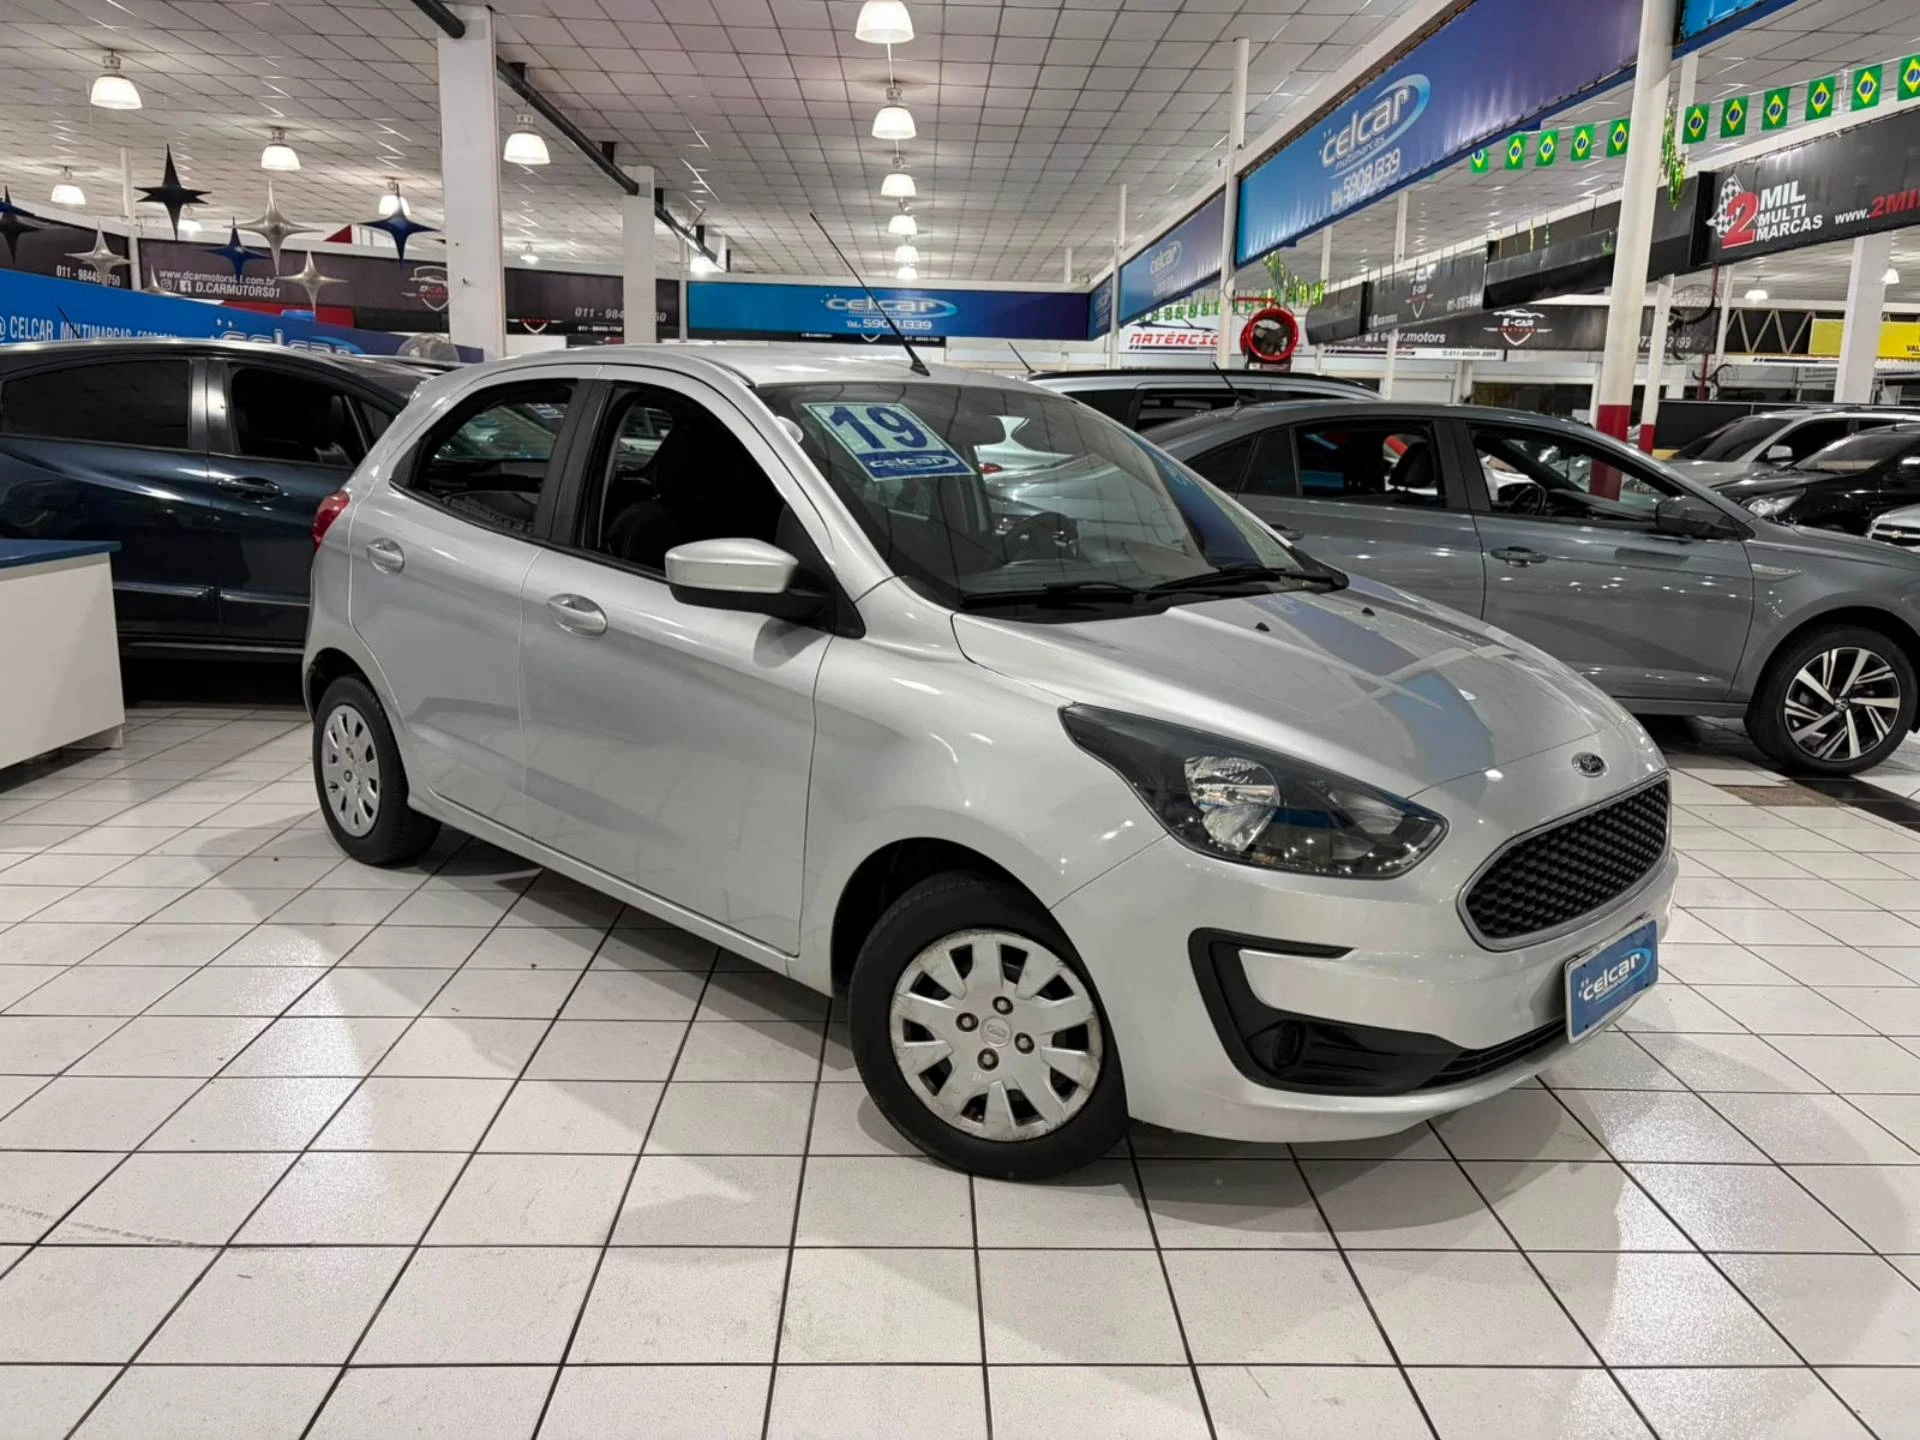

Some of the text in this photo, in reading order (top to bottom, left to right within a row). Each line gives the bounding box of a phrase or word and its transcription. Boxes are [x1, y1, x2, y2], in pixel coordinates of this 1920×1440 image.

[1322, 87, 1409, 168] celcar
[1722, 180, 1806, 249] 2 MIL
[1757, 203, 1808, 227] MULTI
[1756, 214, 1824, 242] MARCAS
[56, 265, 70, 278] 011
[575, 307, 594, 317] 011
[825, 297, 936, 313] celcar
[10, 315, 54, 340] CELCAR
[1502, 318, 1534, 327] E-CAR
[830, 407, 928, 449] 19
[1583, 953, 1641, 1001] celcar
